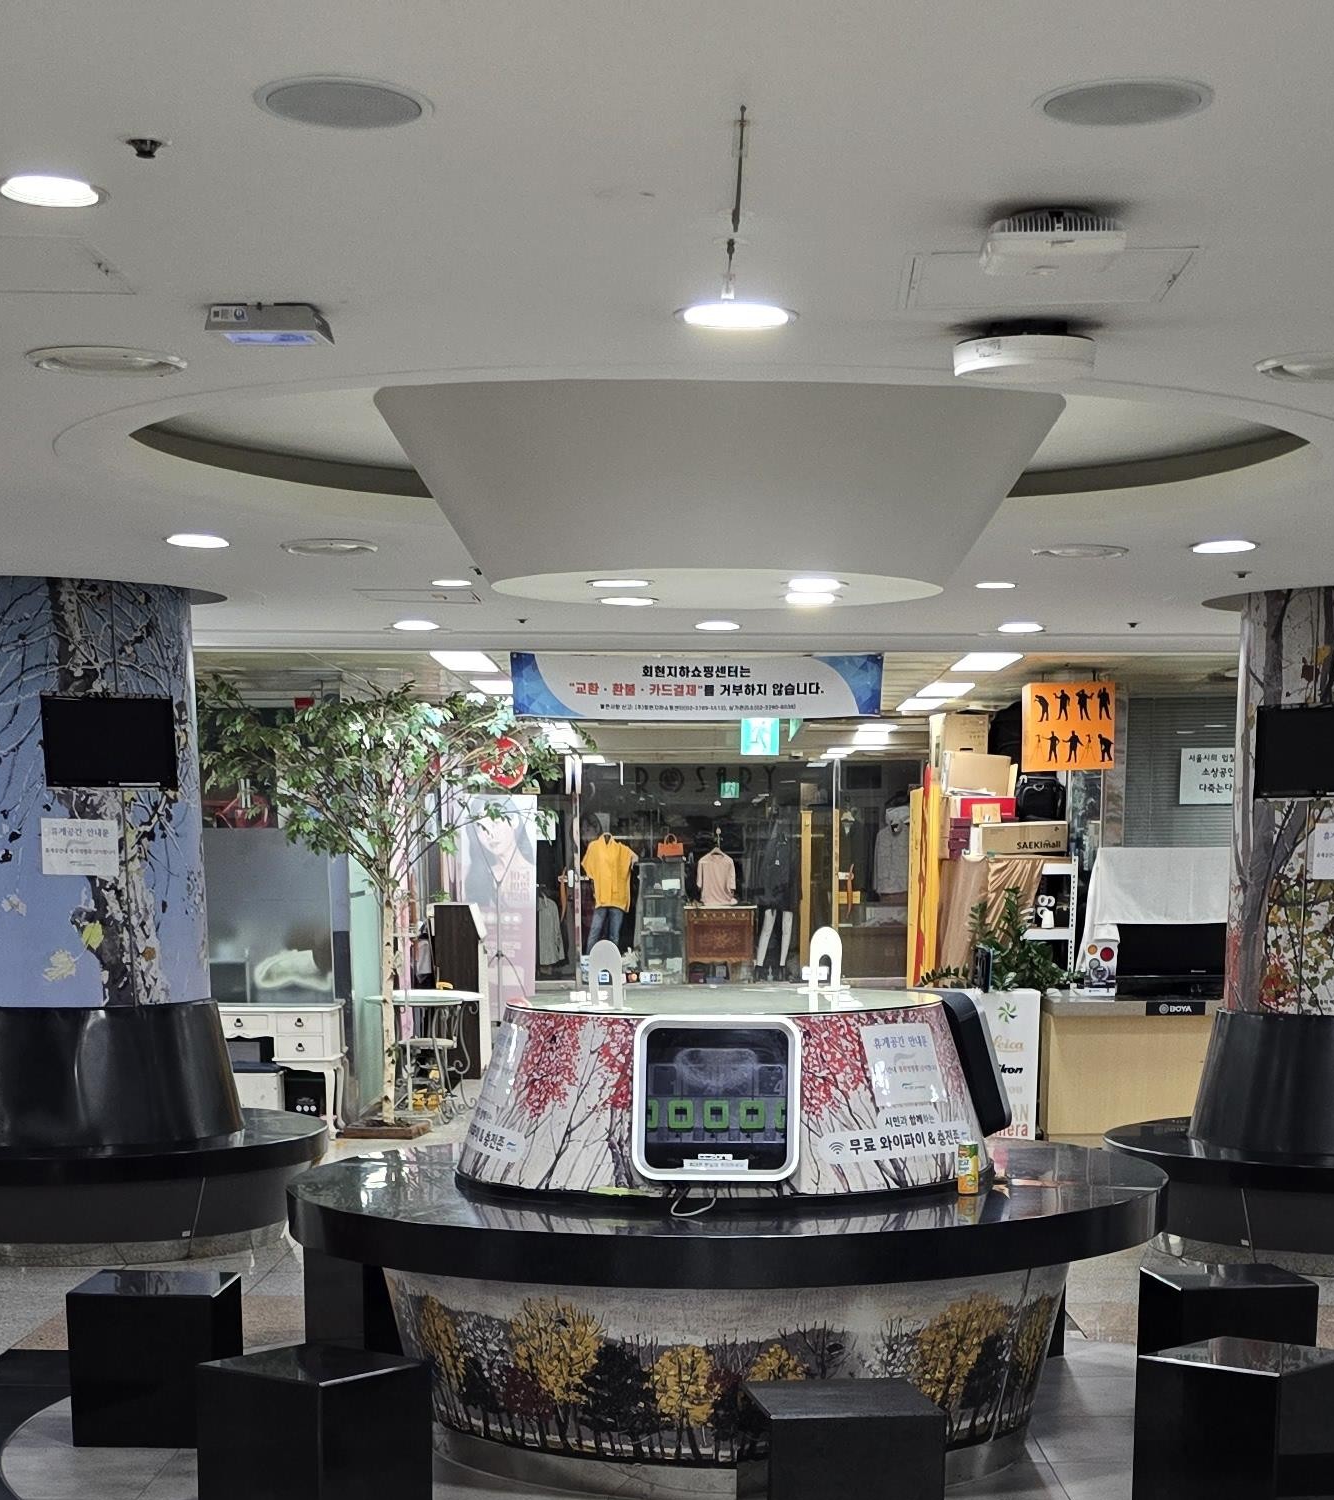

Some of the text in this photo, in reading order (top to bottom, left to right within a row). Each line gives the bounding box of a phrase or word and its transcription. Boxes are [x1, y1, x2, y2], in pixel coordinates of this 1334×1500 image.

[641, 664, 752, 679] 회현지하쇼핑센터는
[611, 683, 636, 697] 환불
[719, 683, 768, 697] 거부하지
[772, 682, 825, 697] 않습니다.
[1169, 1005, 1193, 1013] BOYA
[873, 1034, 906, 1049] 휴게공간
[998, 1063, 1024, 1074] kon
[884, 1113, 936, 1128] 시민과 함께하는
[849, 1129, 961, 1155] 무료 와이파이 & 충전존
